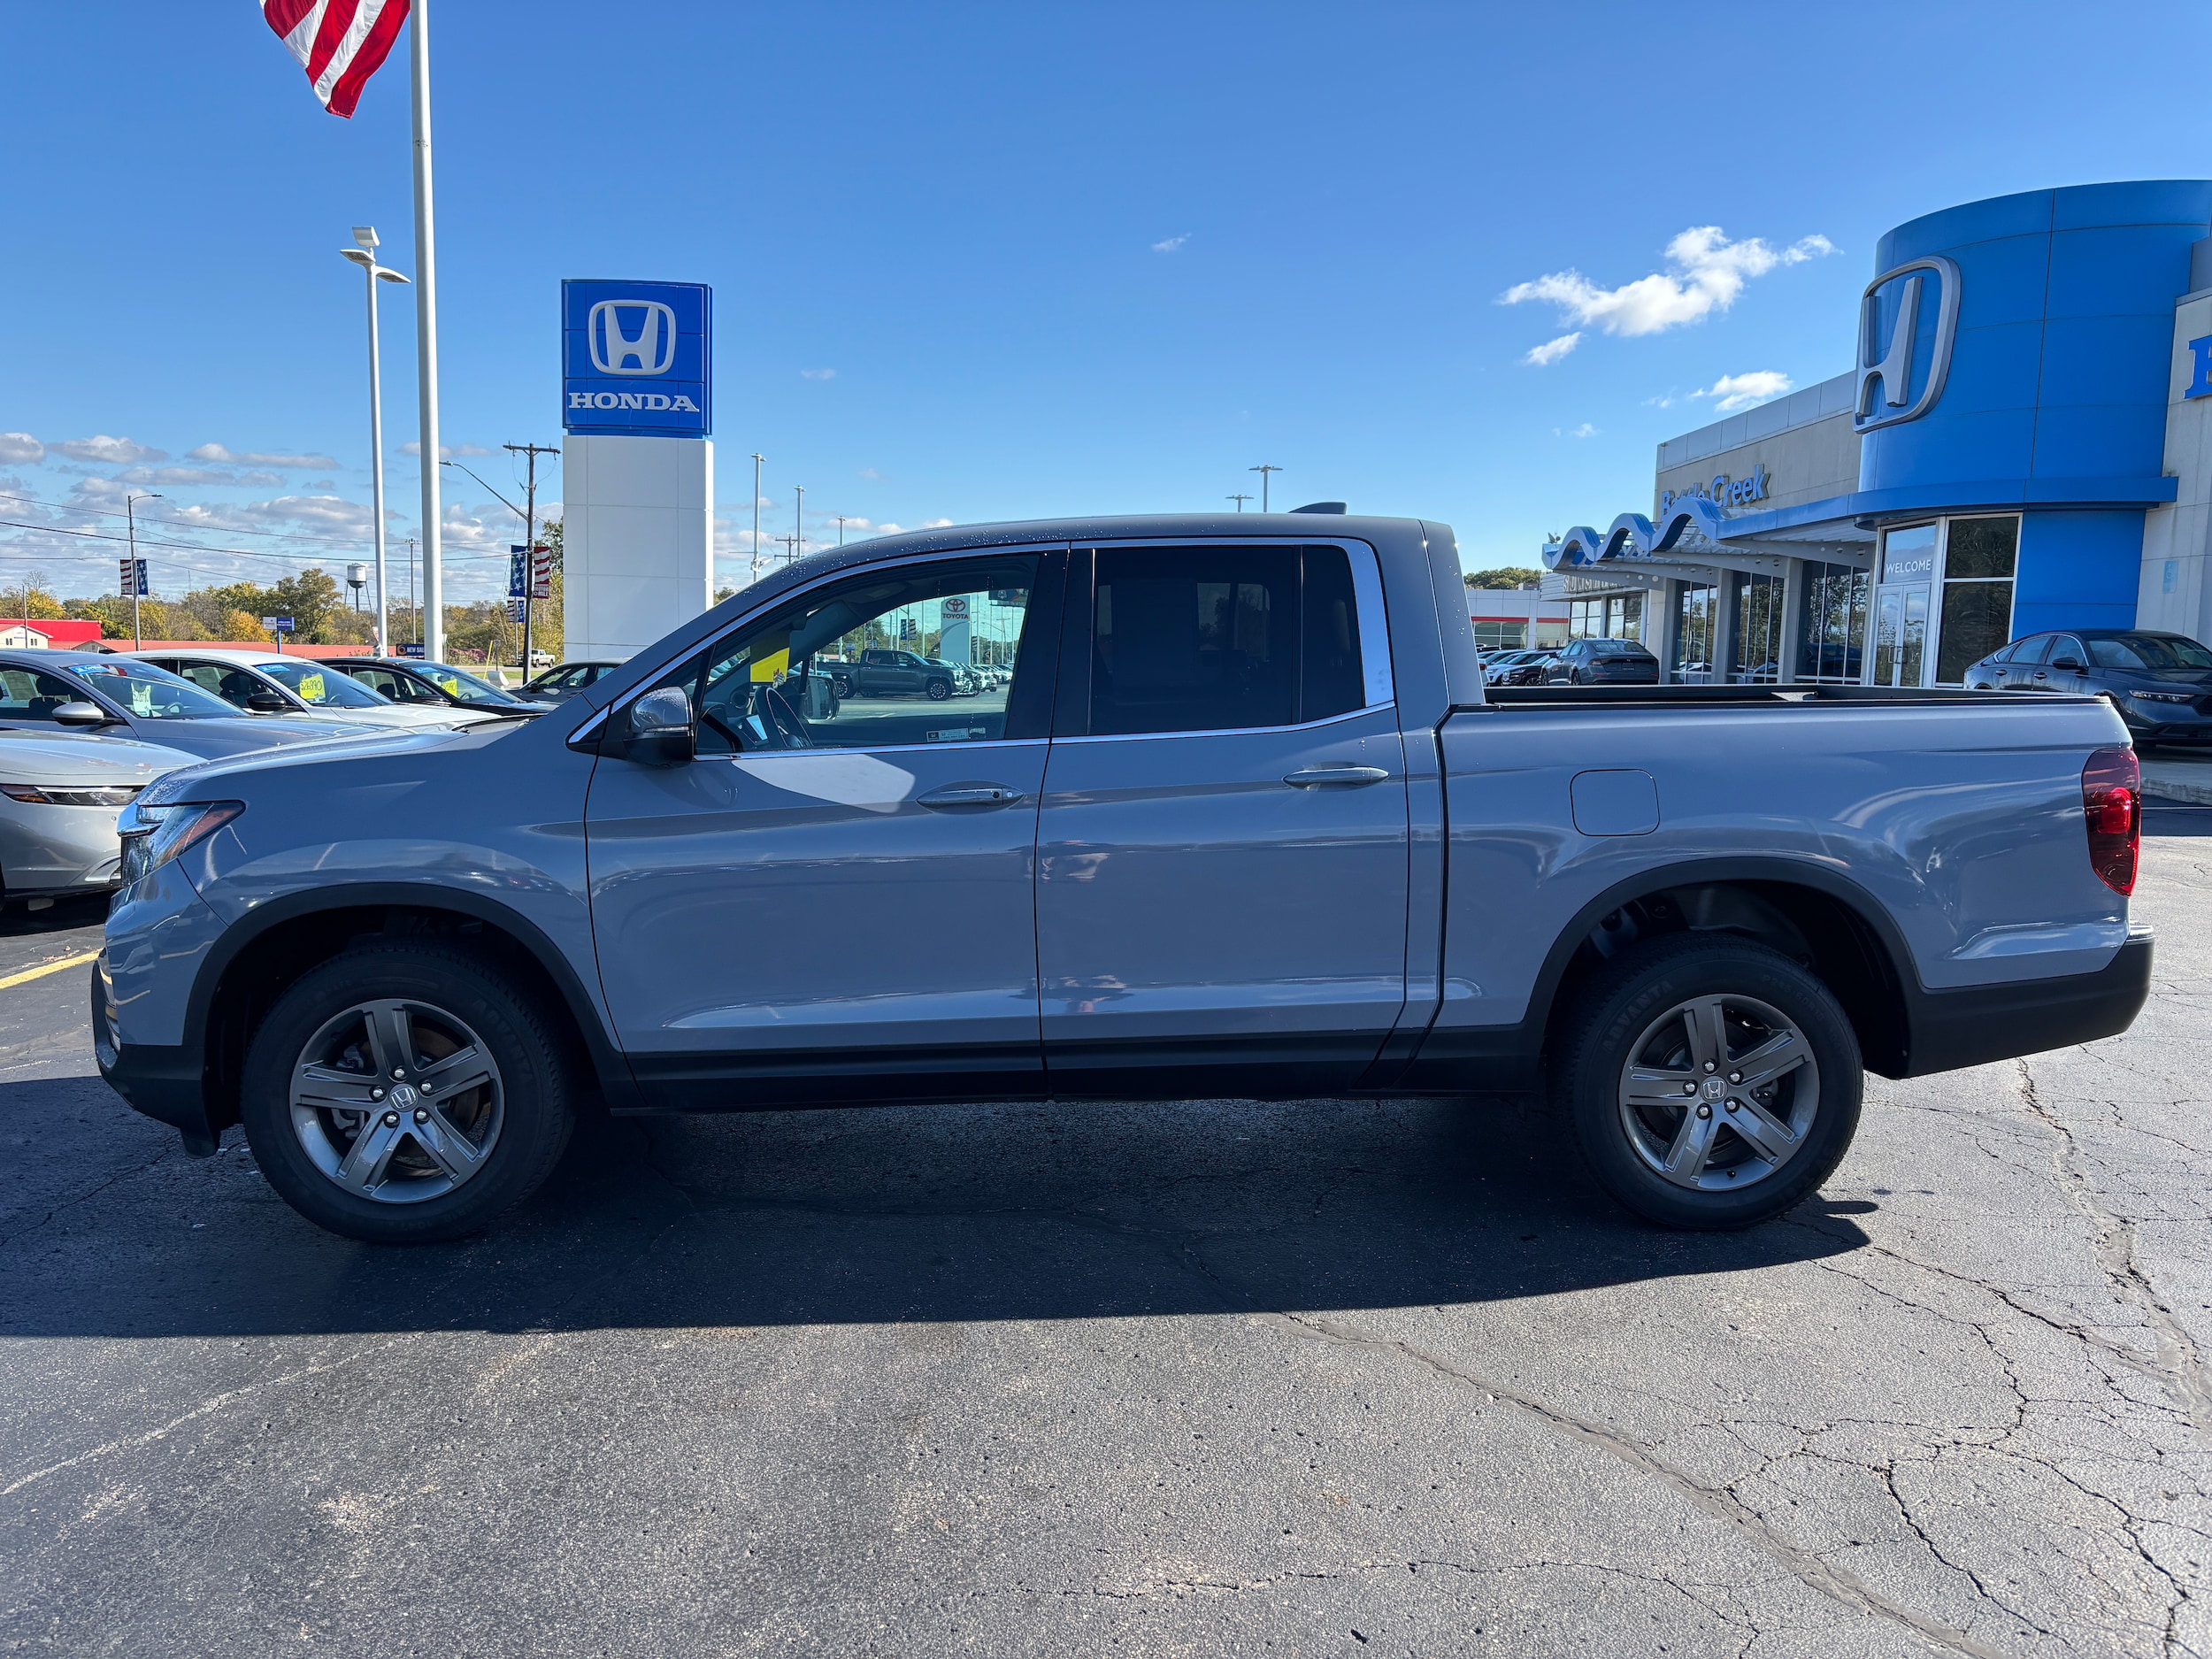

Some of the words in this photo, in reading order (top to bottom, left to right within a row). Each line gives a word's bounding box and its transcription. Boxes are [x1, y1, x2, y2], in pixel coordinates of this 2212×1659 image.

[568, 391, 700, 413] HONDA
[1710, 464, 1770, 507] Creek
[1886, 558, 1933, 574] WELCOME
